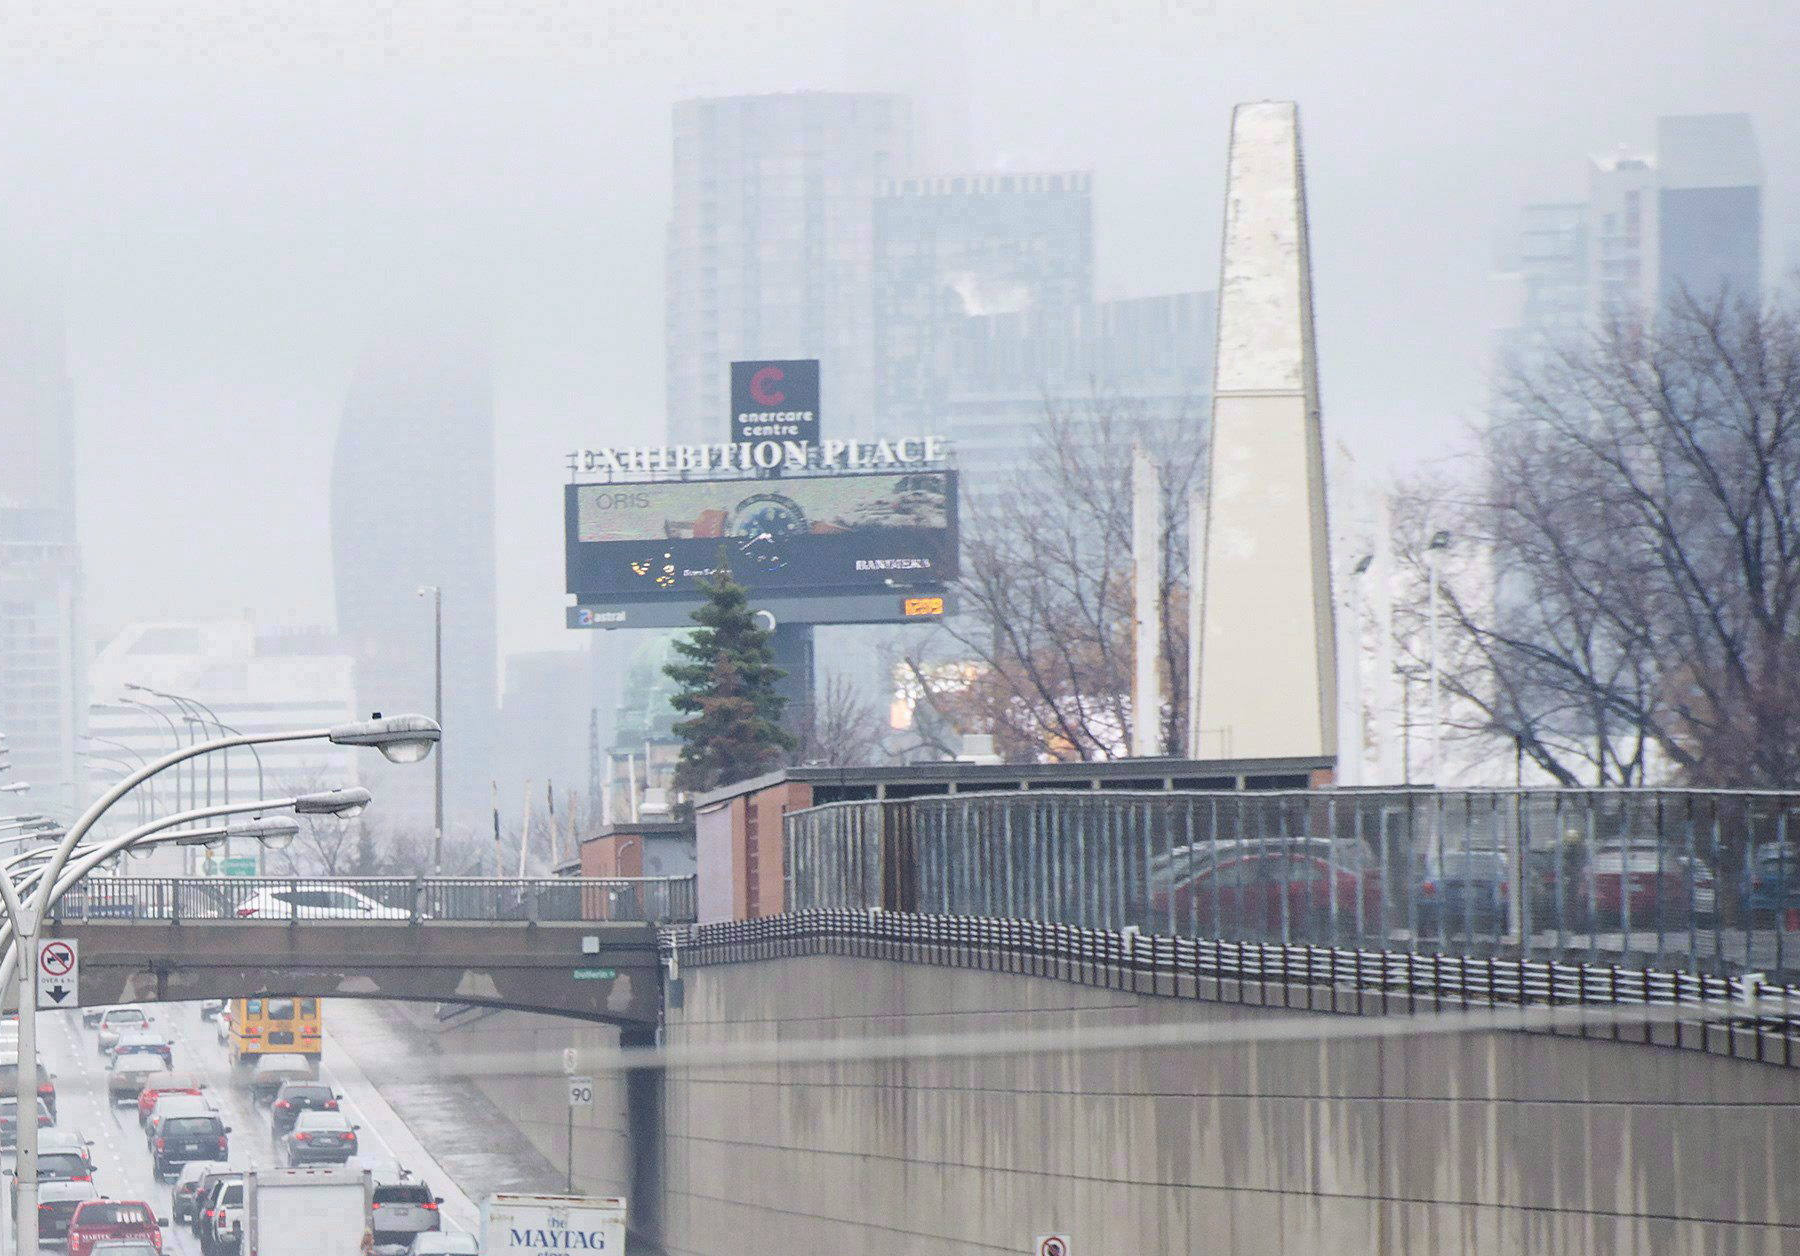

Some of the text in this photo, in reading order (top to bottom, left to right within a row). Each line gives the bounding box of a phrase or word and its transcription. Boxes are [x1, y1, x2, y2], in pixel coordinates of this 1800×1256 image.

[738, 410, 814, 424] enercare
[742, 423, 799, 437] centre
[575, 435, 946, 473] EXHIBITION PLACE
[595, 492, 650, 510] ORIS
[572, 1087, 591, 1102] 90
[548, 1217, 567, 1228] the
[510, 1229, 605, 1250] MAYTAG
